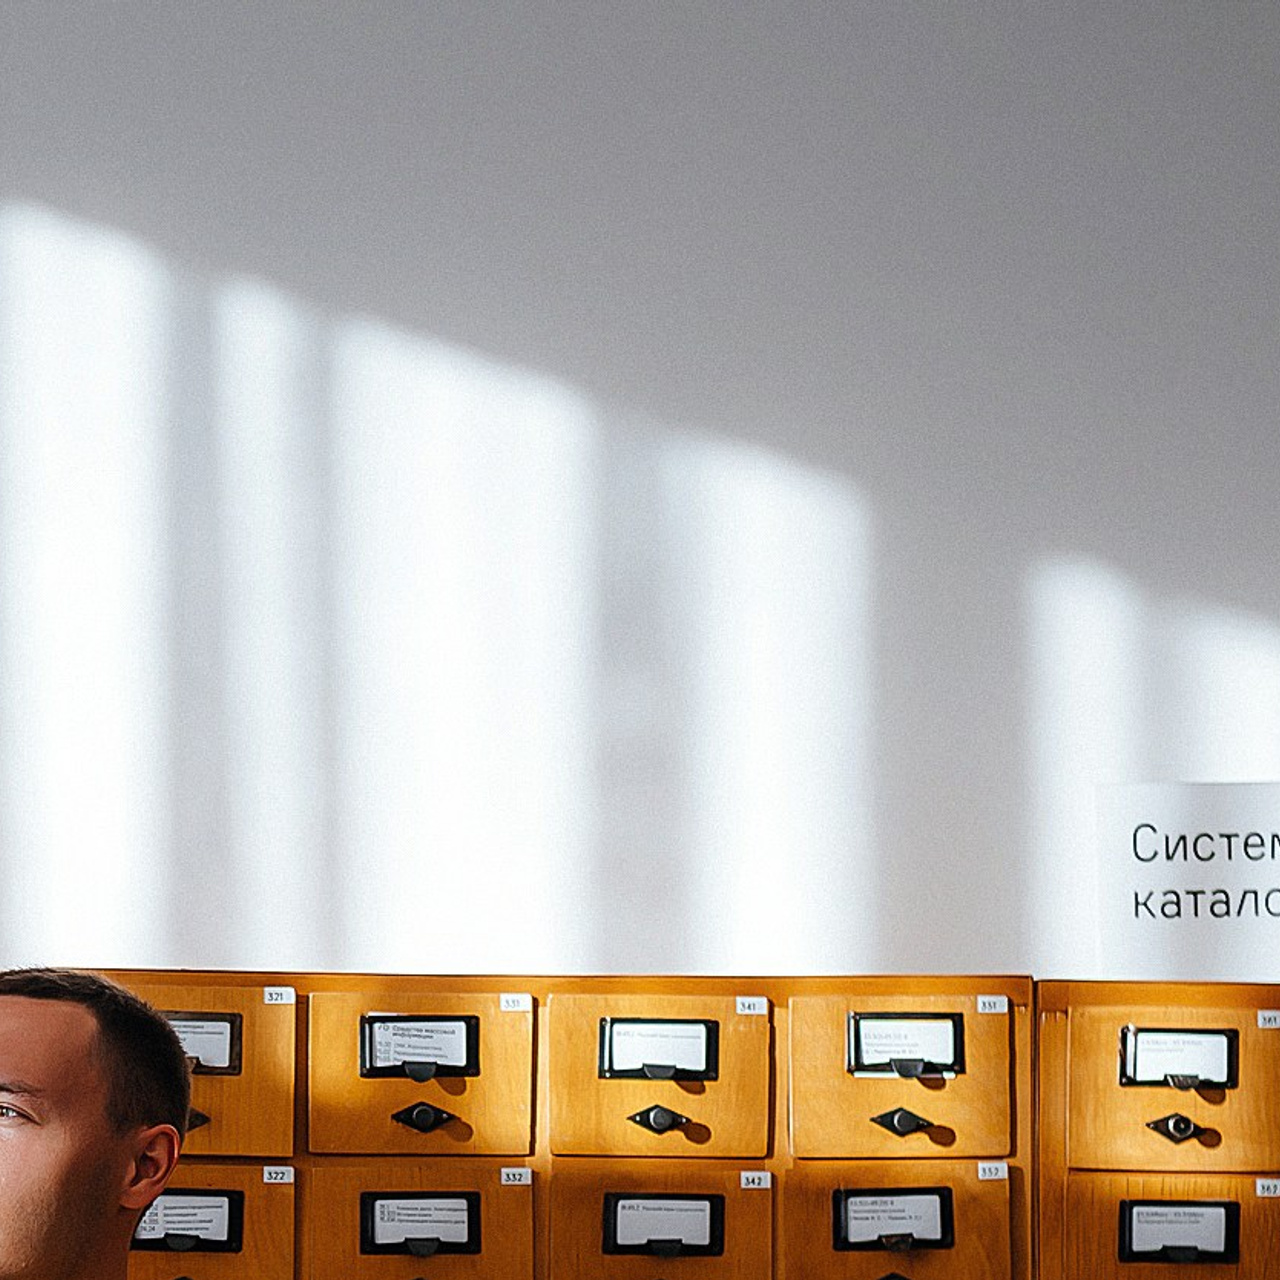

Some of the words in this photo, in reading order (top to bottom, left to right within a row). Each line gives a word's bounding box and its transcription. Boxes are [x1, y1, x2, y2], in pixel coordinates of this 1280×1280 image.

[267, 991, 284, 1002] 321
[739, 1001, 757, 1012] 341
[266, 1170, 286, 1181] 322
[504, 1172, 524, 1183] 332
[744, 1176, 763, 1187] 342
